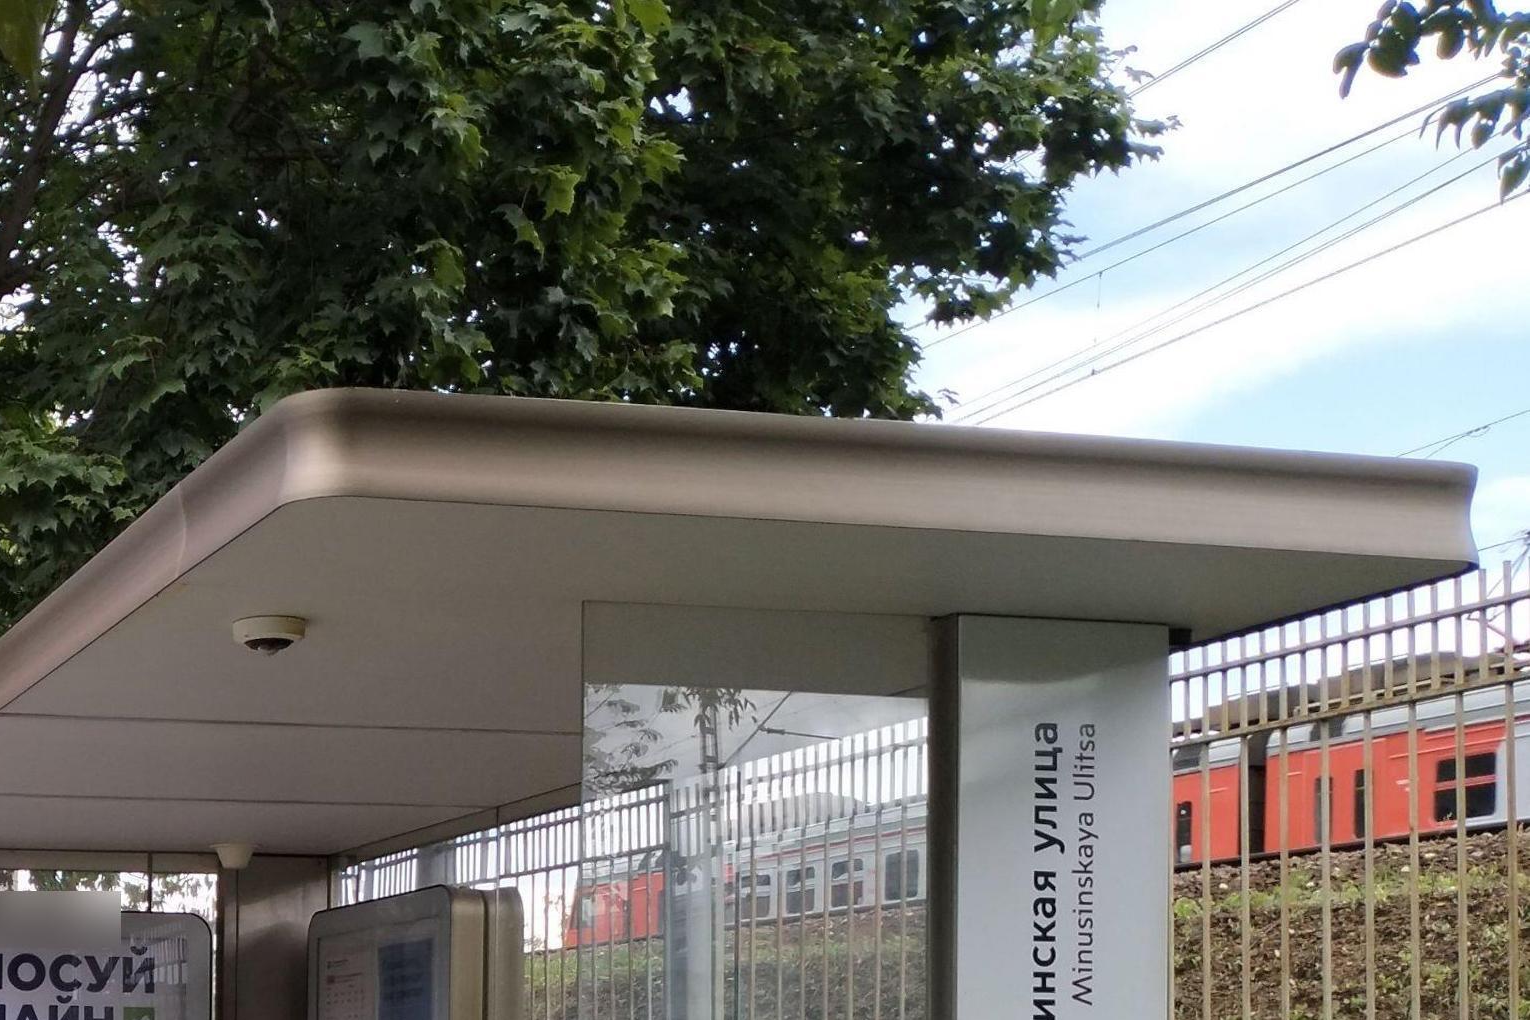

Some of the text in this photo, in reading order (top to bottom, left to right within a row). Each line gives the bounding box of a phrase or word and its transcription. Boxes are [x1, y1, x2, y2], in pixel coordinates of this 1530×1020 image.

[1034, 721, 1065, 853] улица
[1072, 722, 1099, 1006] Minusinskaya Ulitsa
